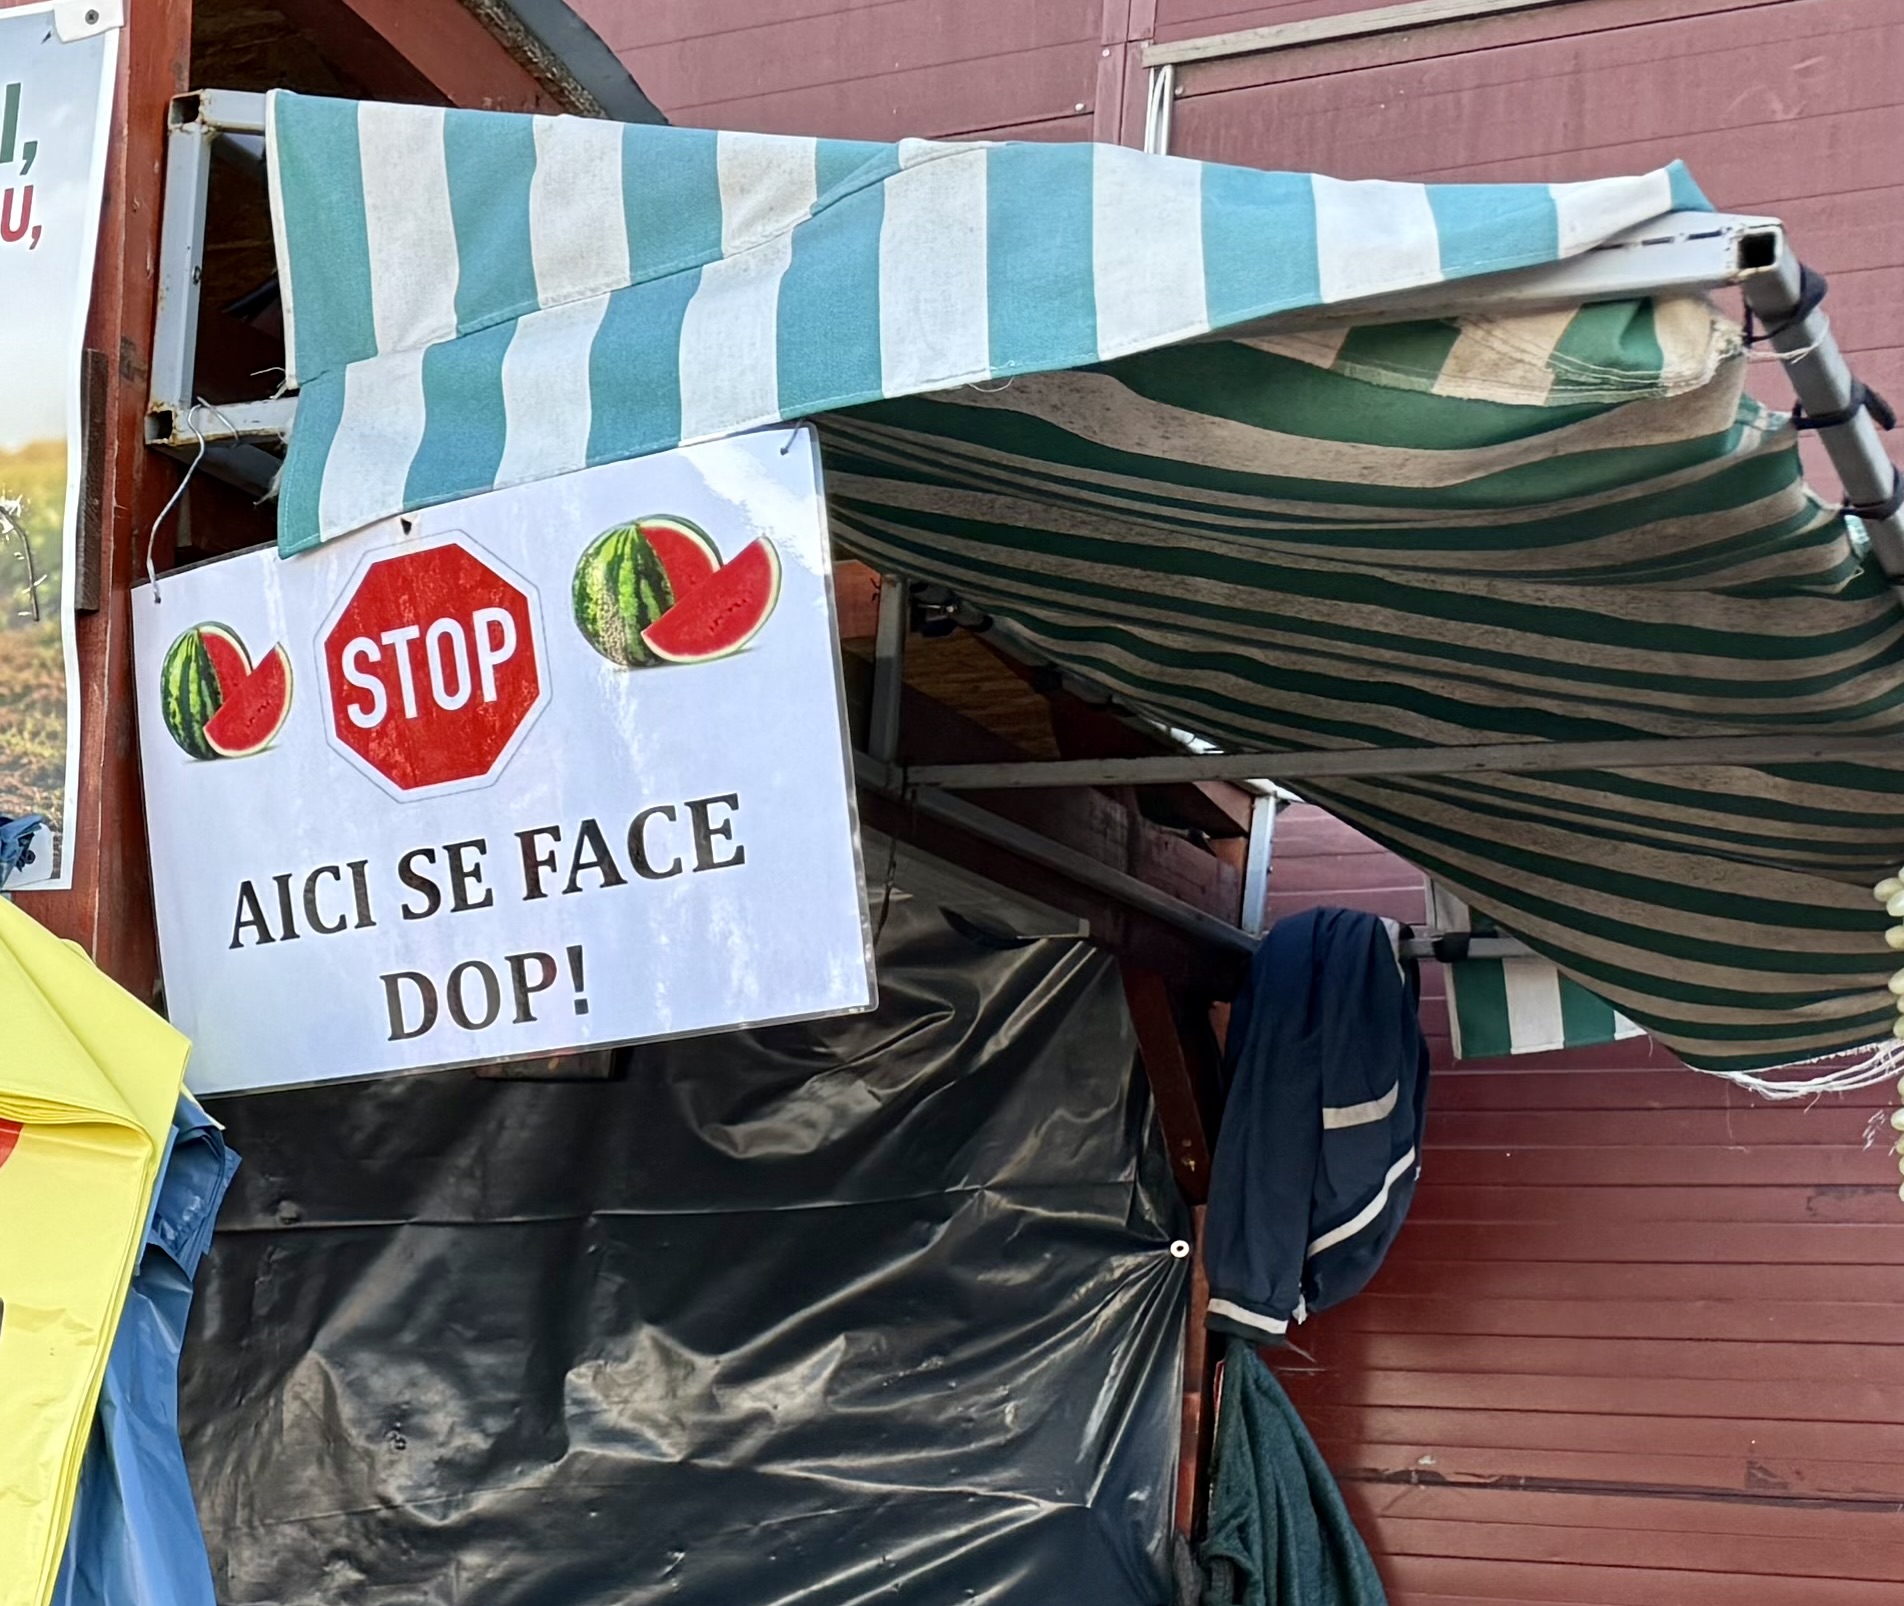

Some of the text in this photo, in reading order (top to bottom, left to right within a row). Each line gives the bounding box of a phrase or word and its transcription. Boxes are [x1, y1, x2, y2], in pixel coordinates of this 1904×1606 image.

[341, 606, 517, 729] STOP
[228, 793, 746, 950] AICI SE FACE
[380, 944, 589, 1042] DOP!
